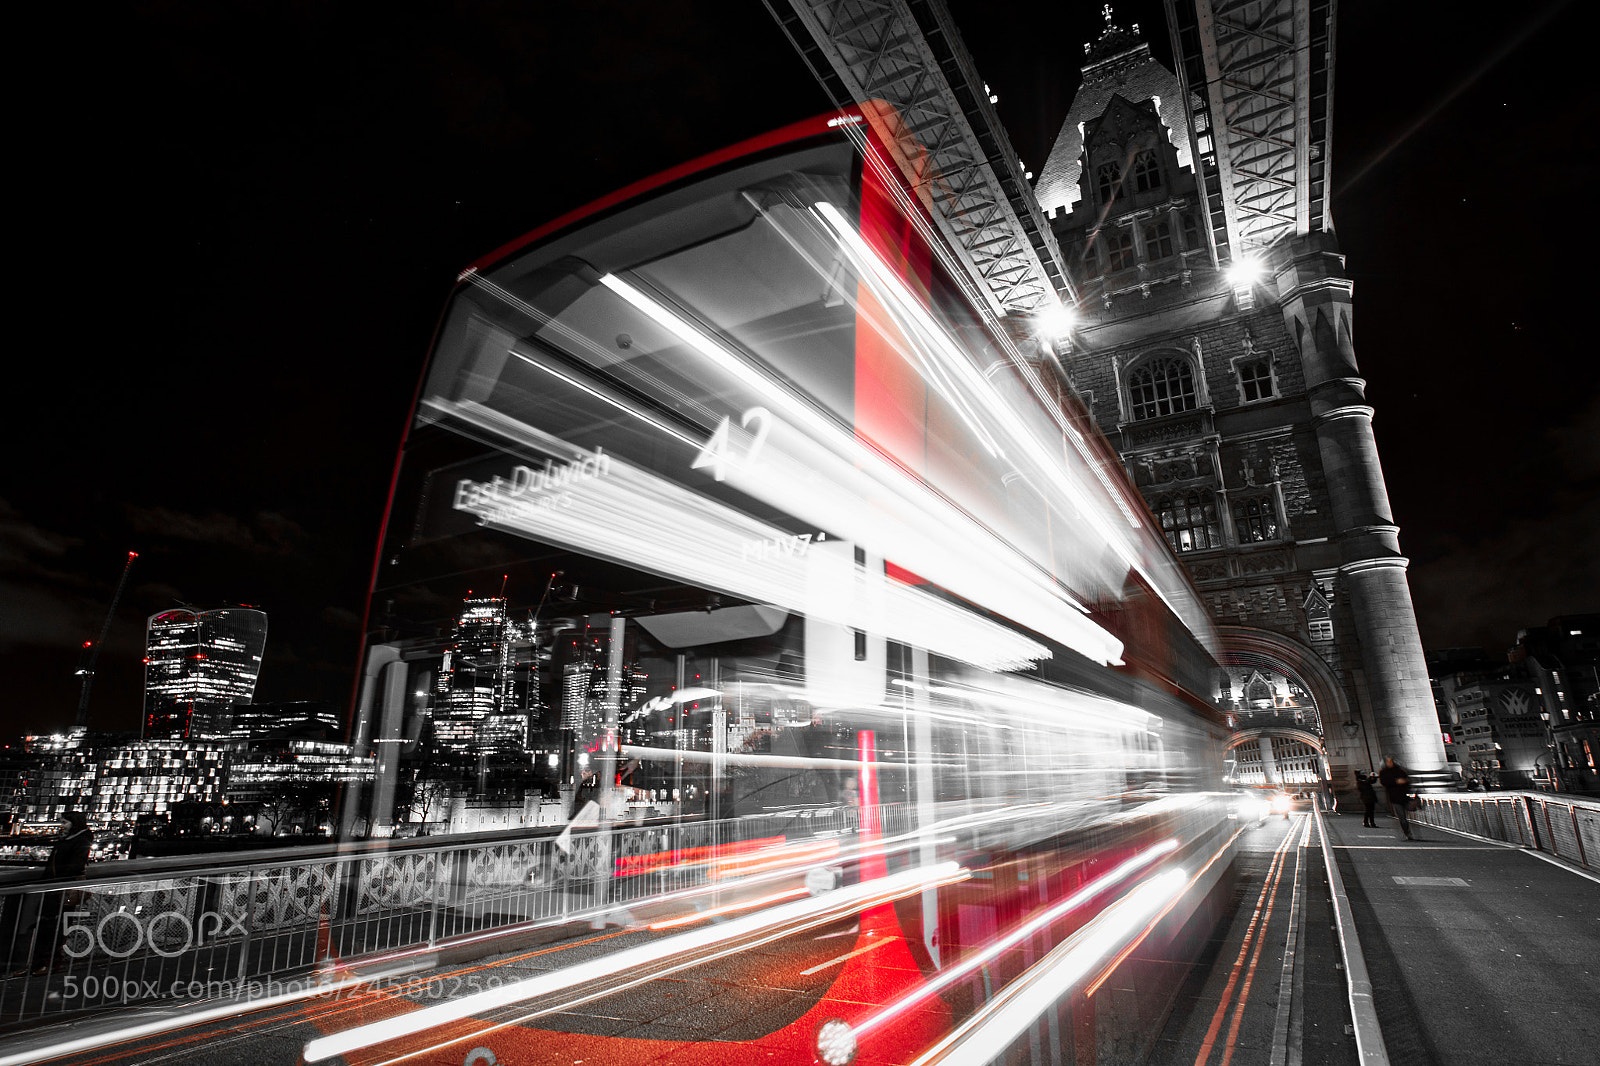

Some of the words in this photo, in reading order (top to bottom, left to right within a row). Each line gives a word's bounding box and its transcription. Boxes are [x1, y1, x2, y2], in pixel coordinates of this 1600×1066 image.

[452, 475, 504, 510] East
[510, 446, 611, 497] Dulwich
[691, 406, 772, 482] 42
